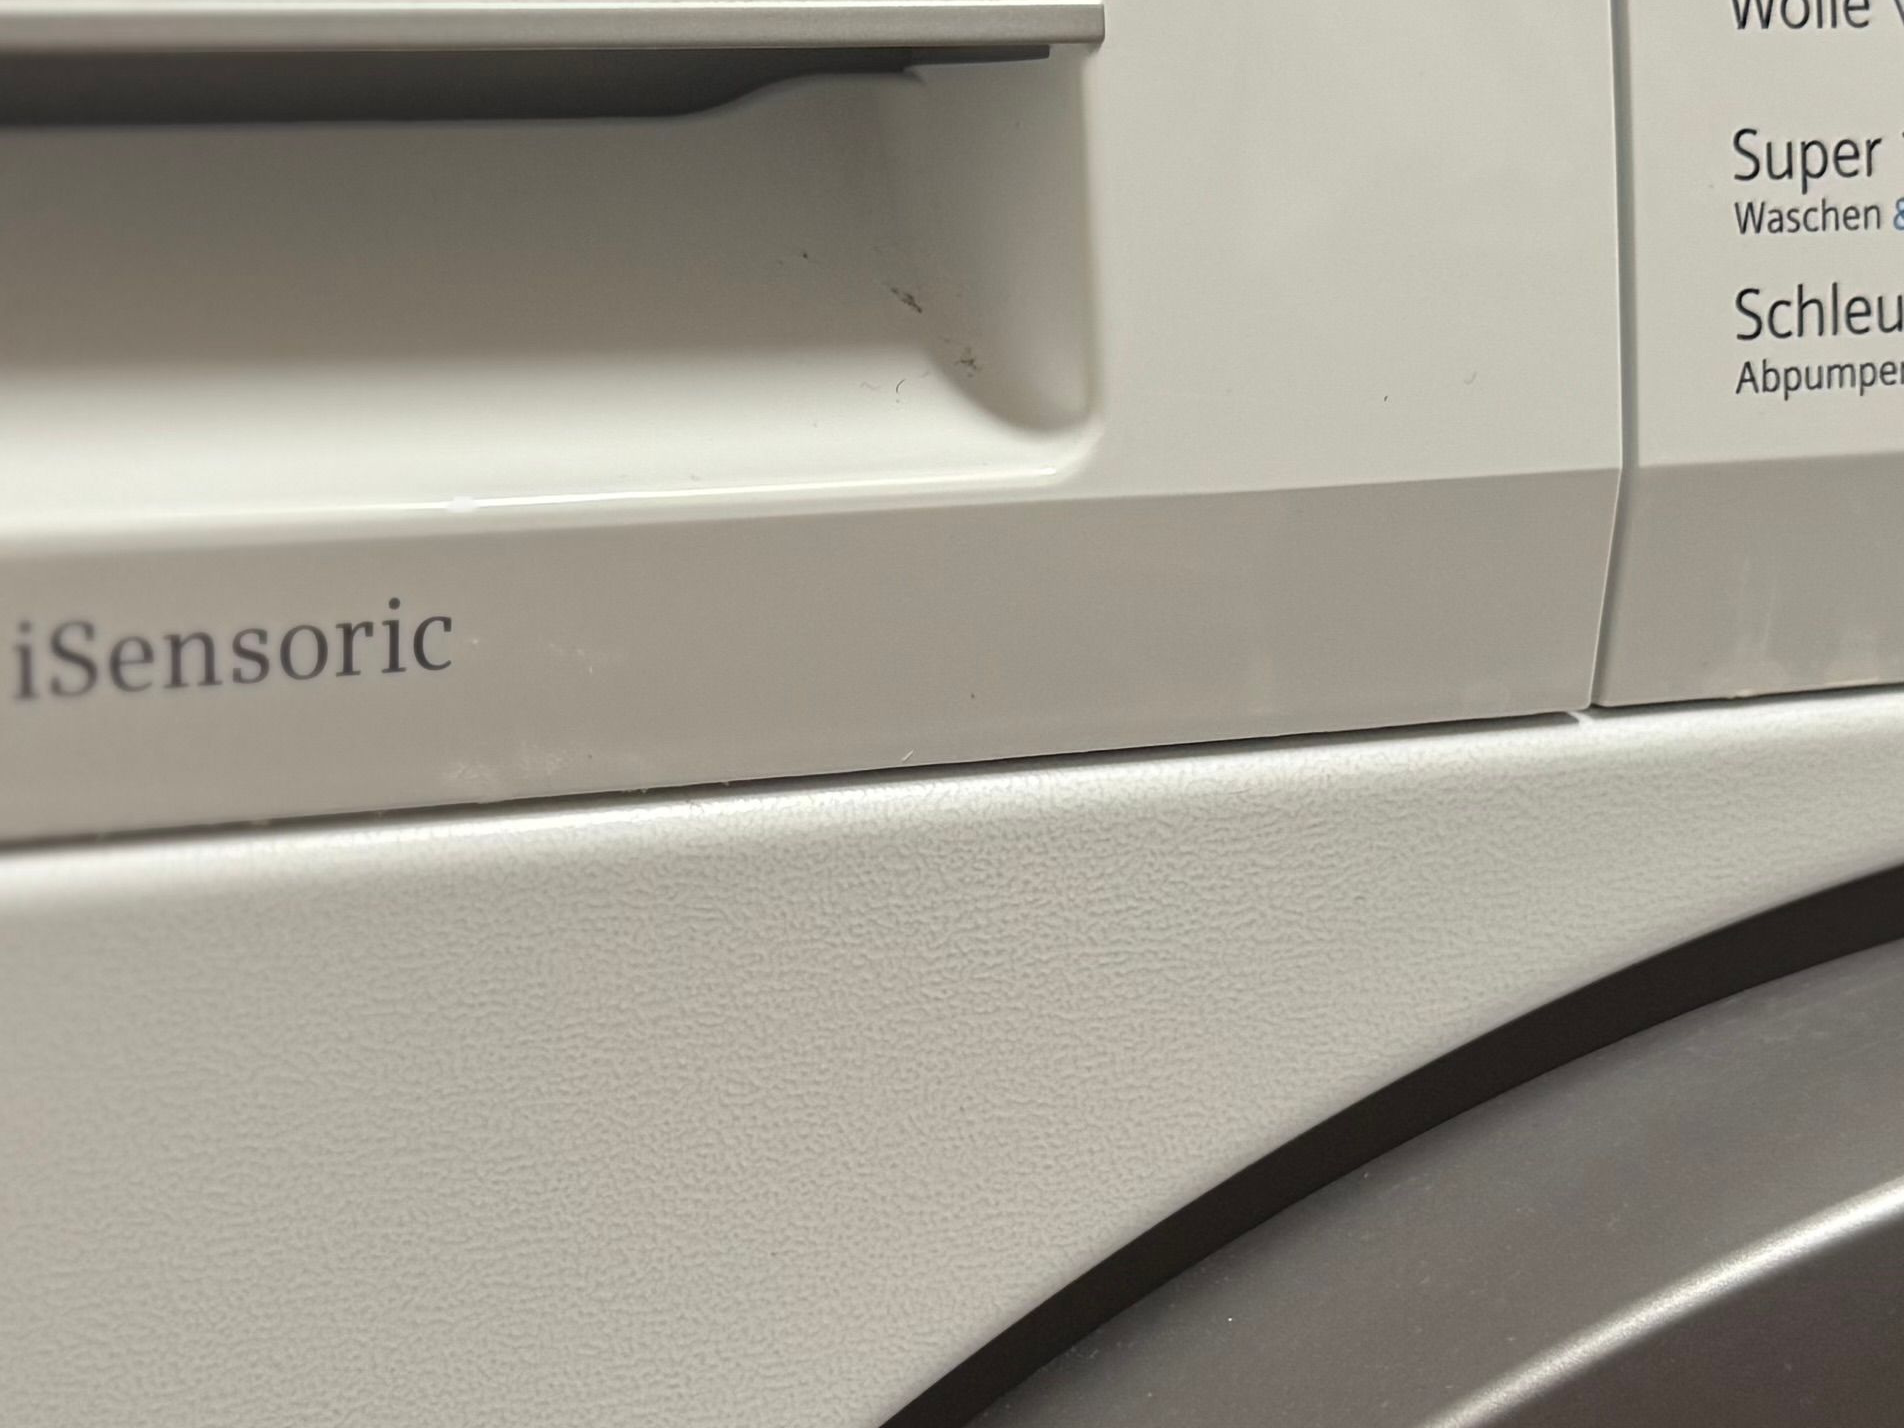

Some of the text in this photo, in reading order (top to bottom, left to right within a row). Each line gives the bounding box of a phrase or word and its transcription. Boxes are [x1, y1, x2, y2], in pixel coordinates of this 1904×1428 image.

[1731, 127, 1882, 194] Super
[1733, 196, 1882, 236] Waschen
[12, 596, 454, 702] iSensoric
